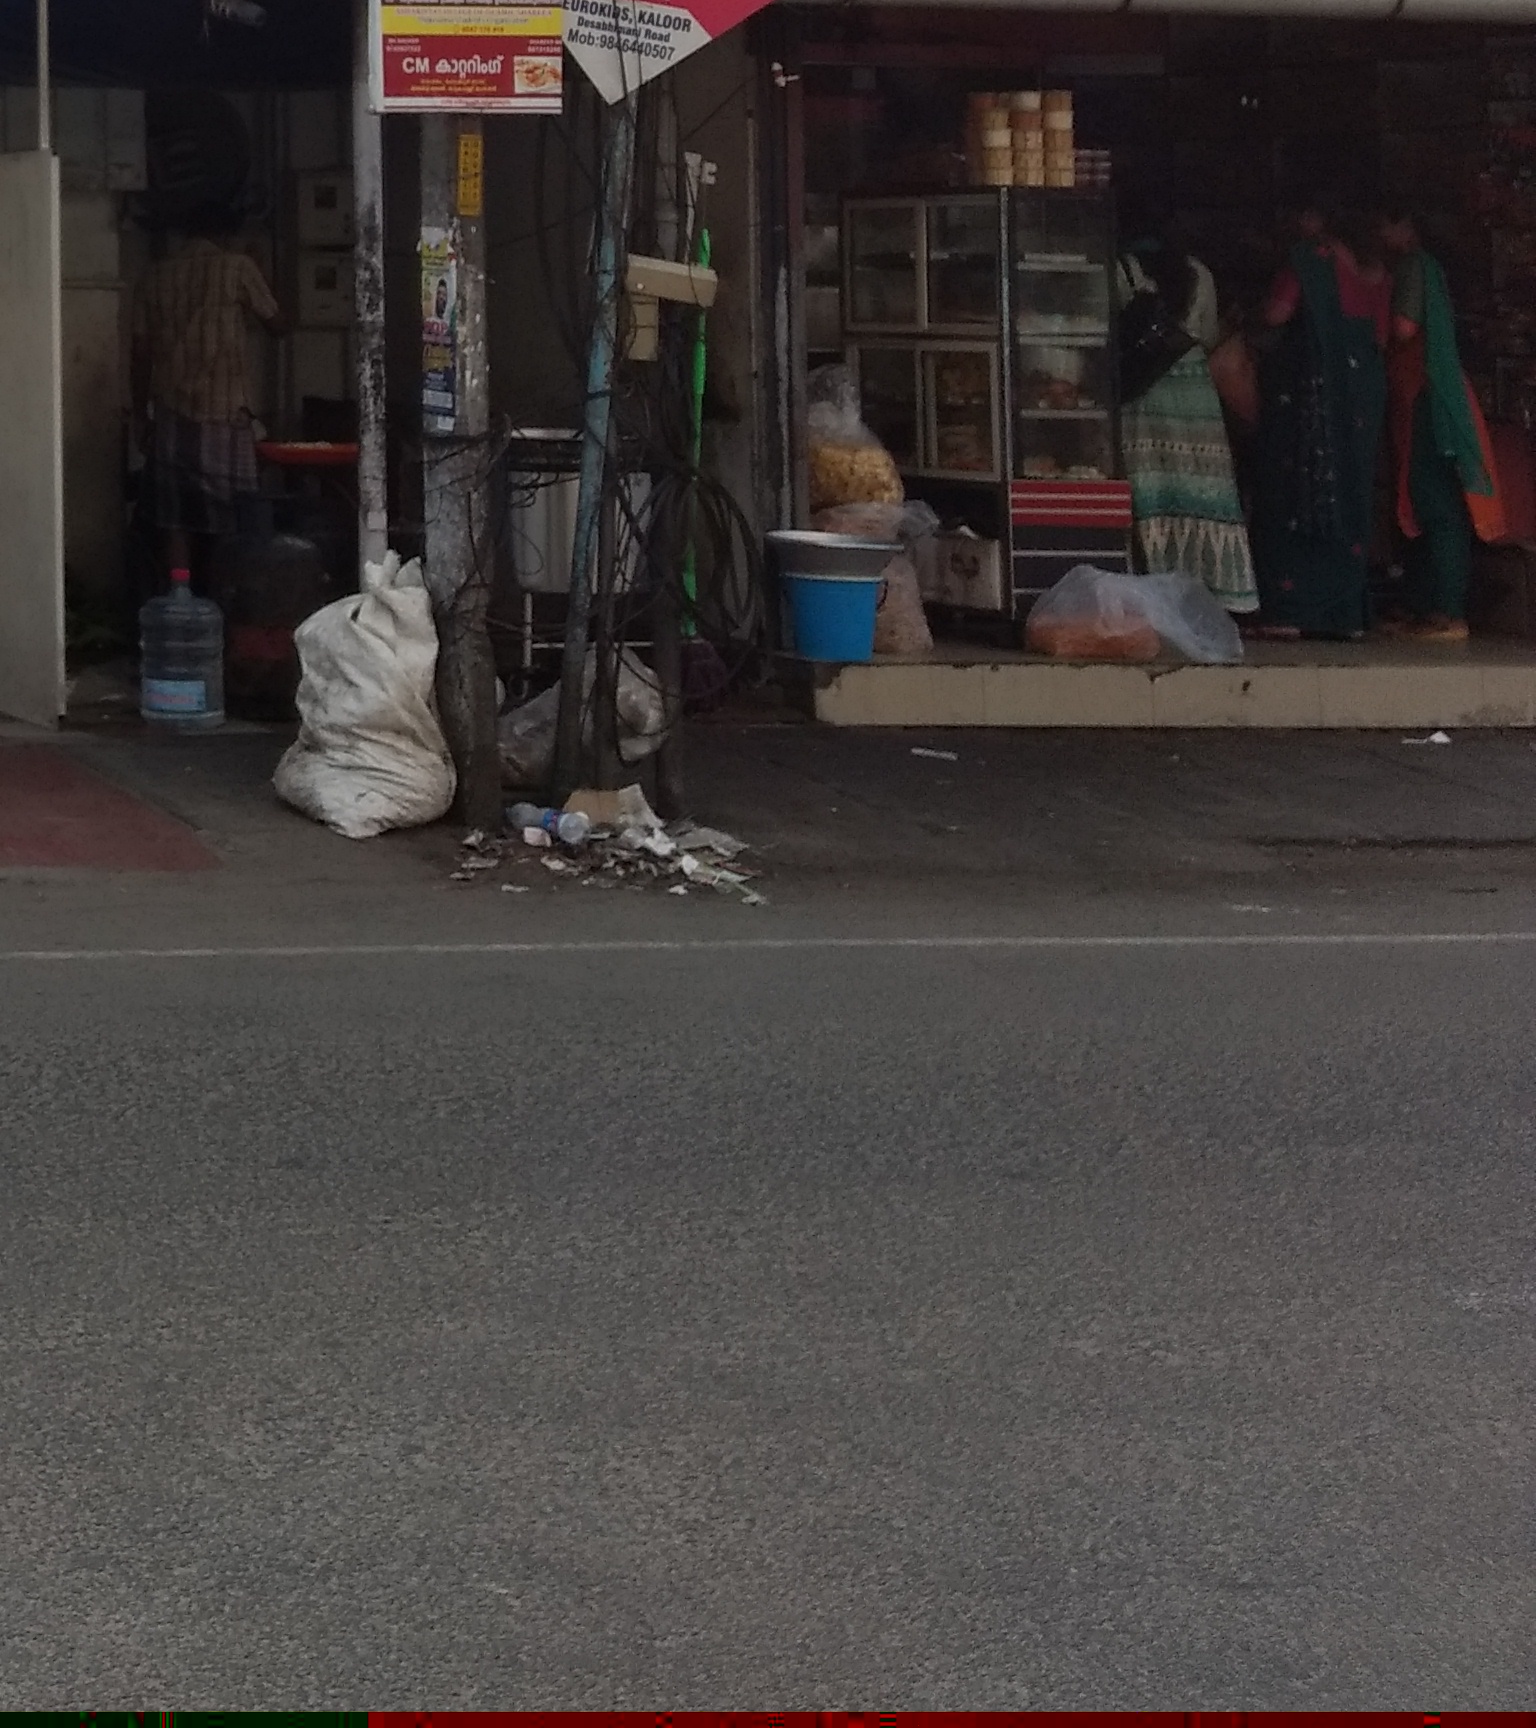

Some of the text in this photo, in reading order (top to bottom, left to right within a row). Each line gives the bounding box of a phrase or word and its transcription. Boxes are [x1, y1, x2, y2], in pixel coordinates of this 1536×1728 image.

[638, 10, 692, 32] KALOOR
[644, 28, 671, 43] Road
[402, 56, 429, 74] CM
